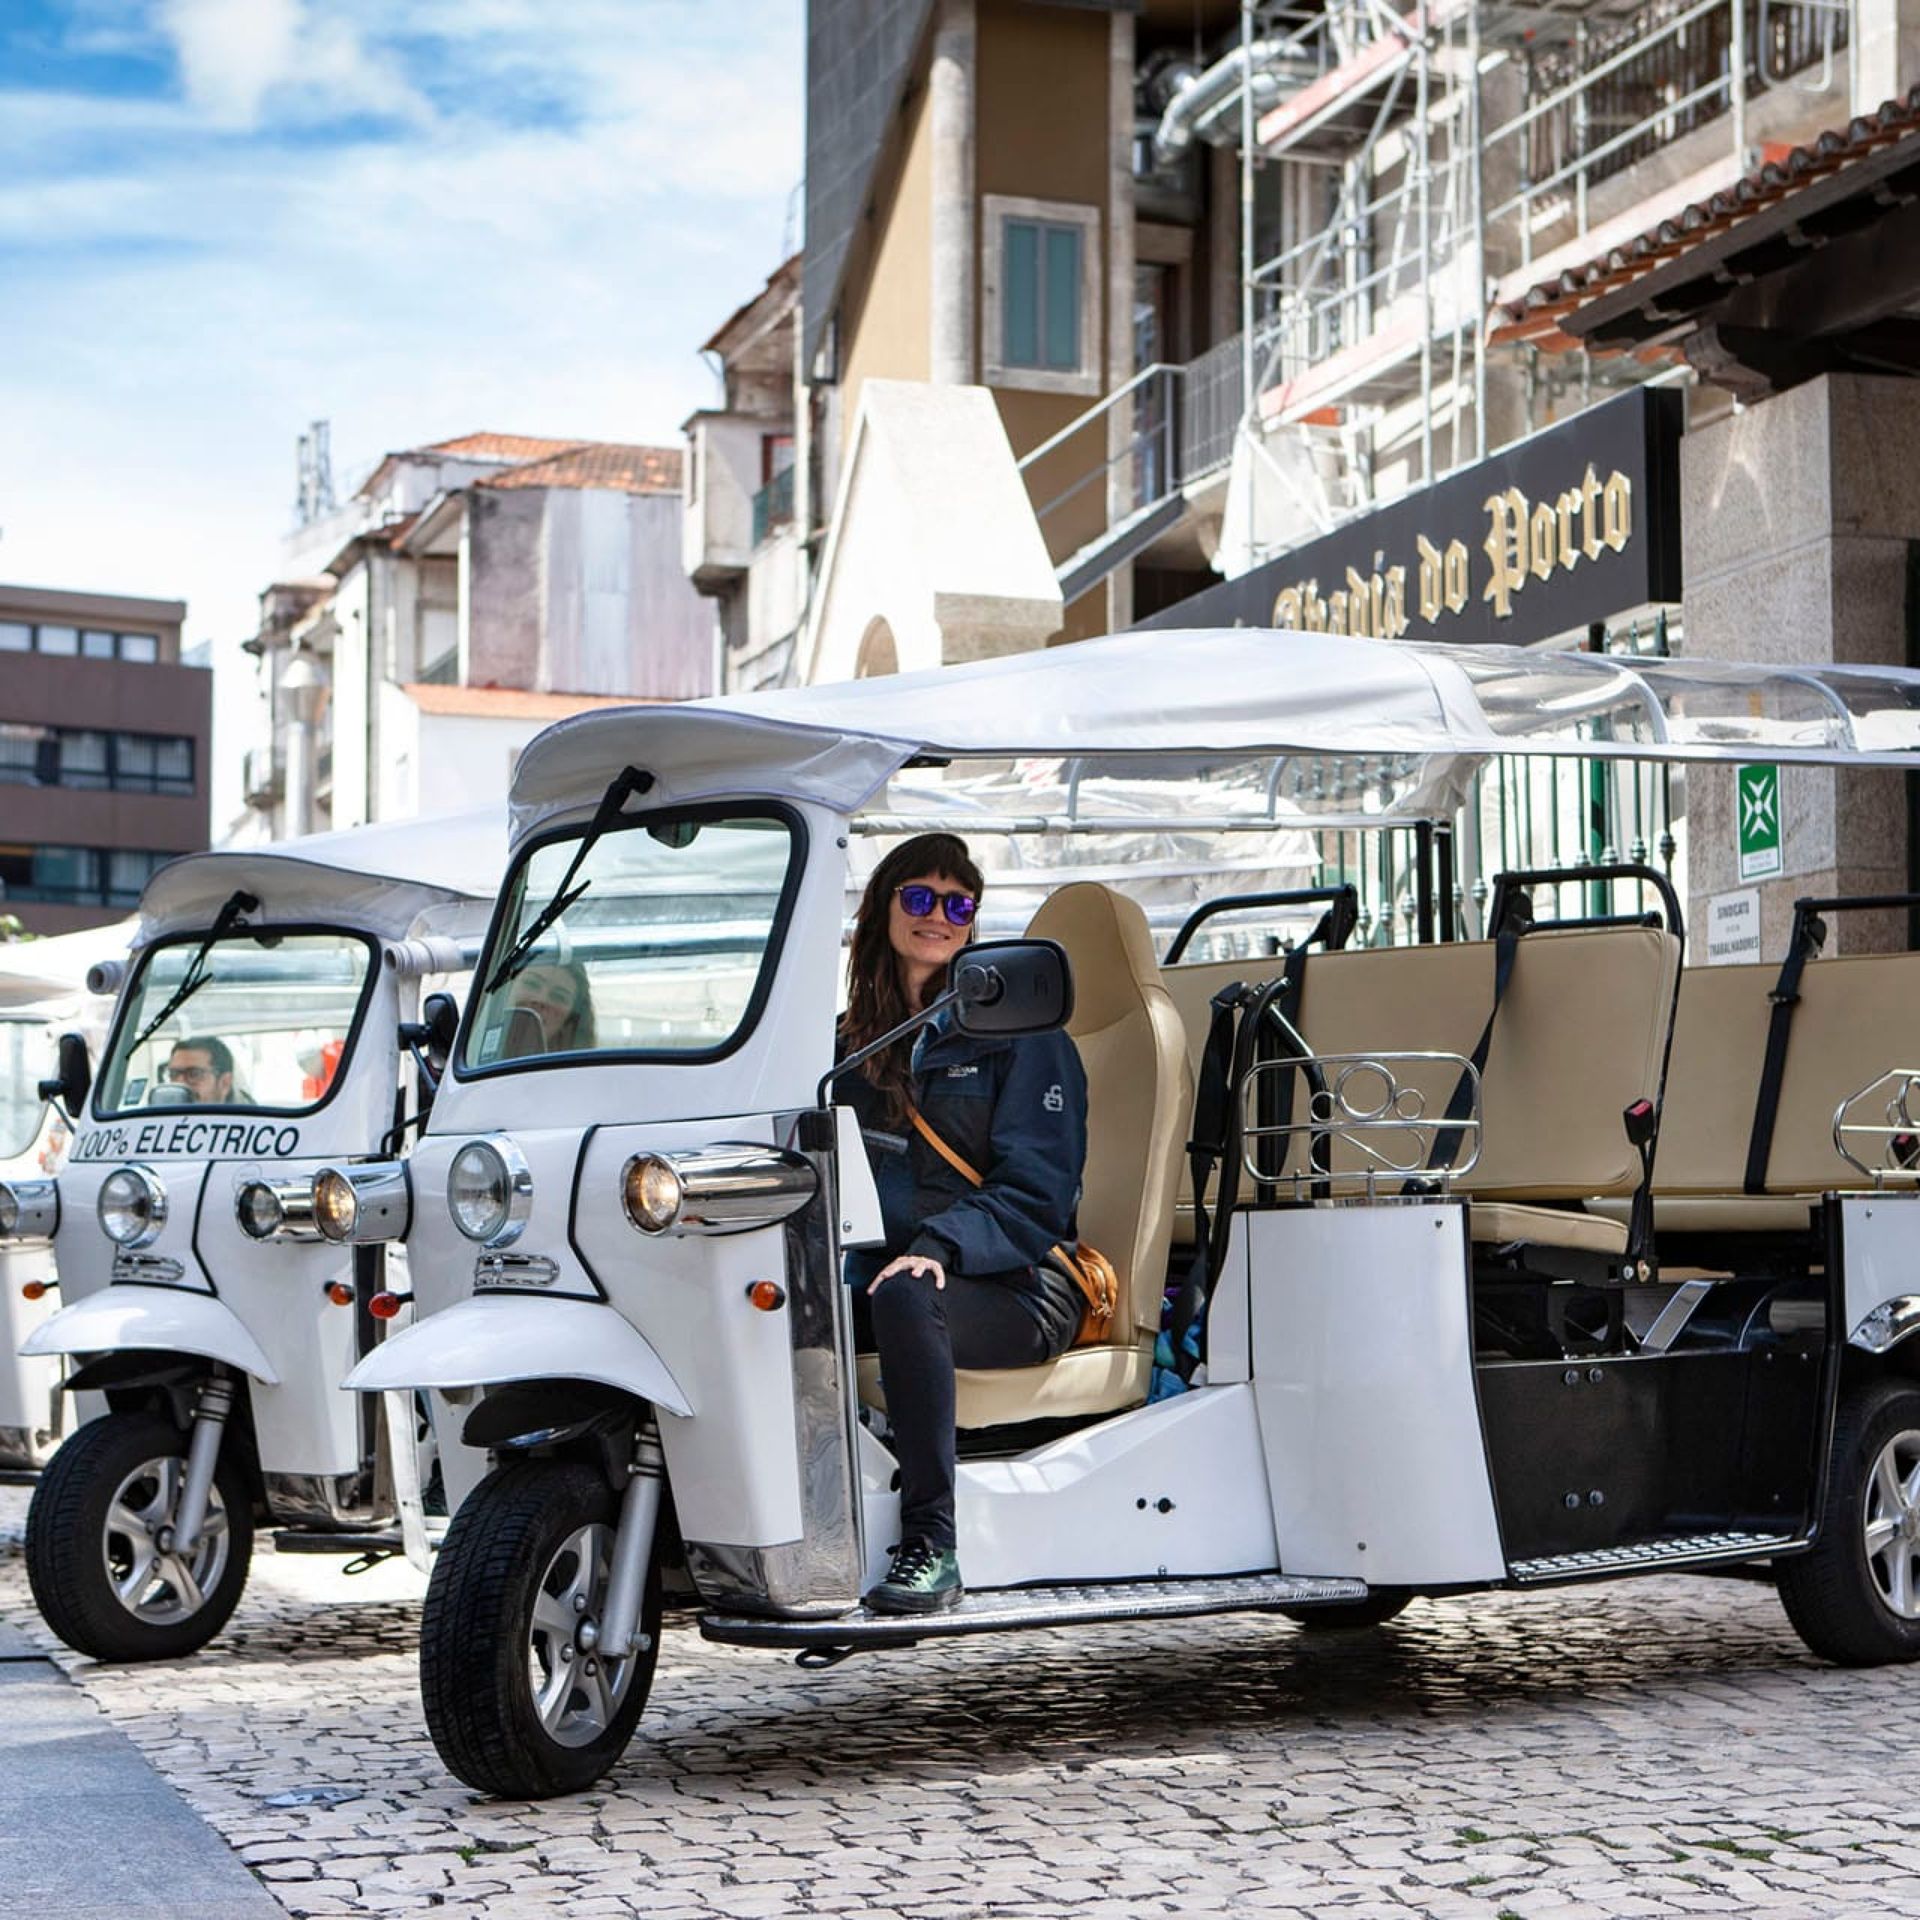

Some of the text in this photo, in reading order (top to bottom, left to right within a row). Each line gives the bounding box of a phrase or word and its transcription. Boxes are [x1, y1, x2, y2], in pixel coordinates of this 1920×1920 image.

[1416, 533, 1469, 624] do
[1483, 461, 1632, 618] Porto
[77, 1116, 300, 1158] 100% ELÉCTRICO
